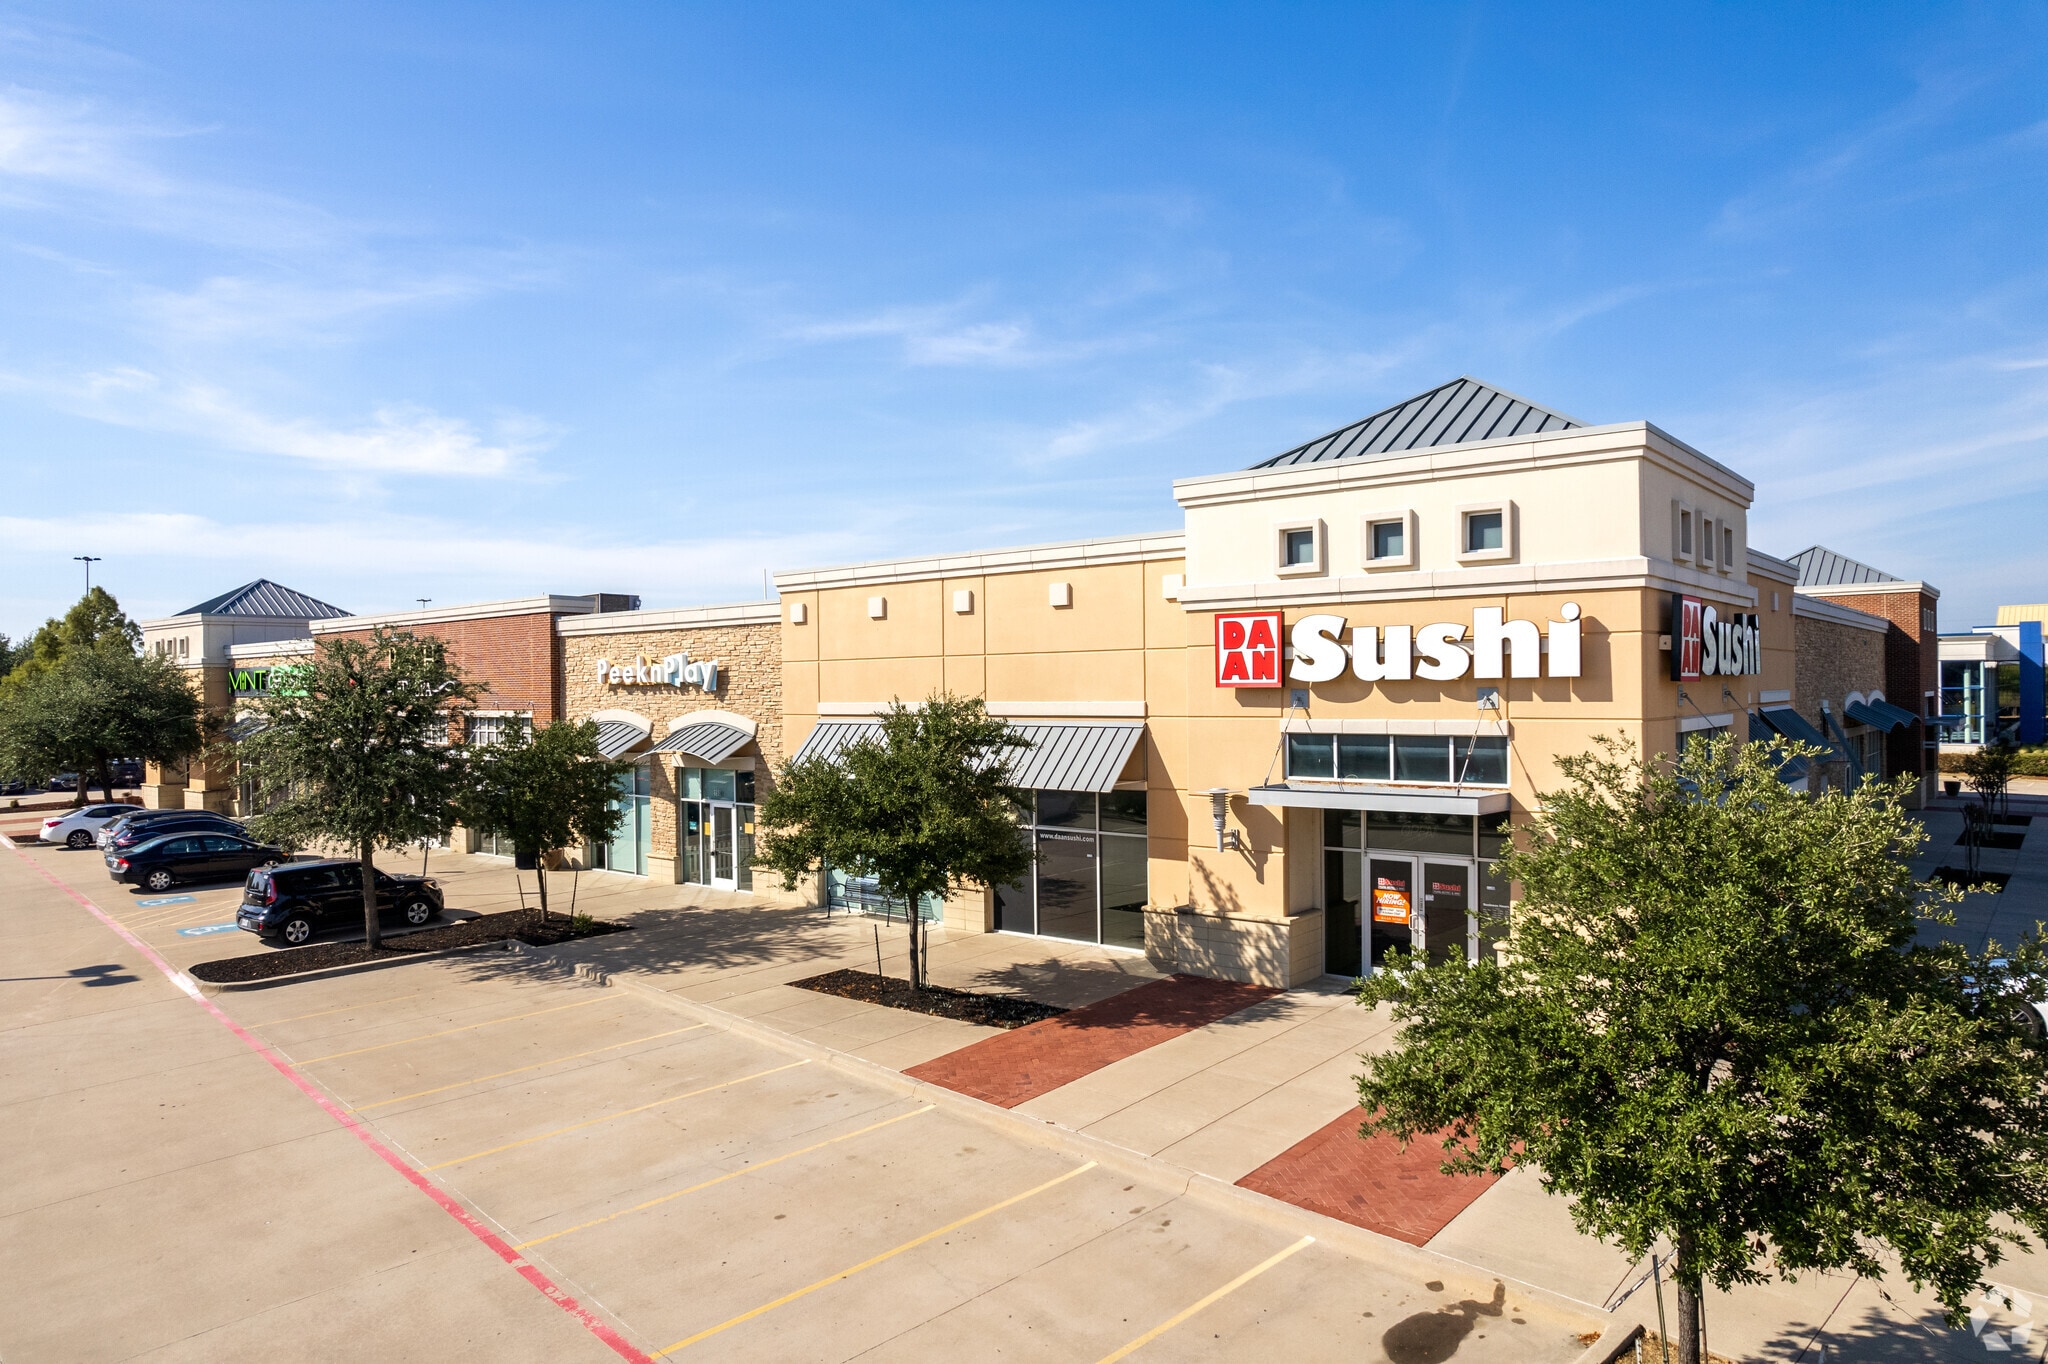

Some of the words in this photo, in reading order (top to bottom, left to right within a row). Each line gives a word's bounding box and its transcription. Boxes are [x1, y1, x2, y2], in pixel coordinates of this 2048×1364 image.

[1289, 602, 1581, 682] Sushi
[1702, 605, 1760, 676] Sushi
[228, 670, 266, 692] MINT
[1040, 833, 1094, 843] www.daansushi.com
